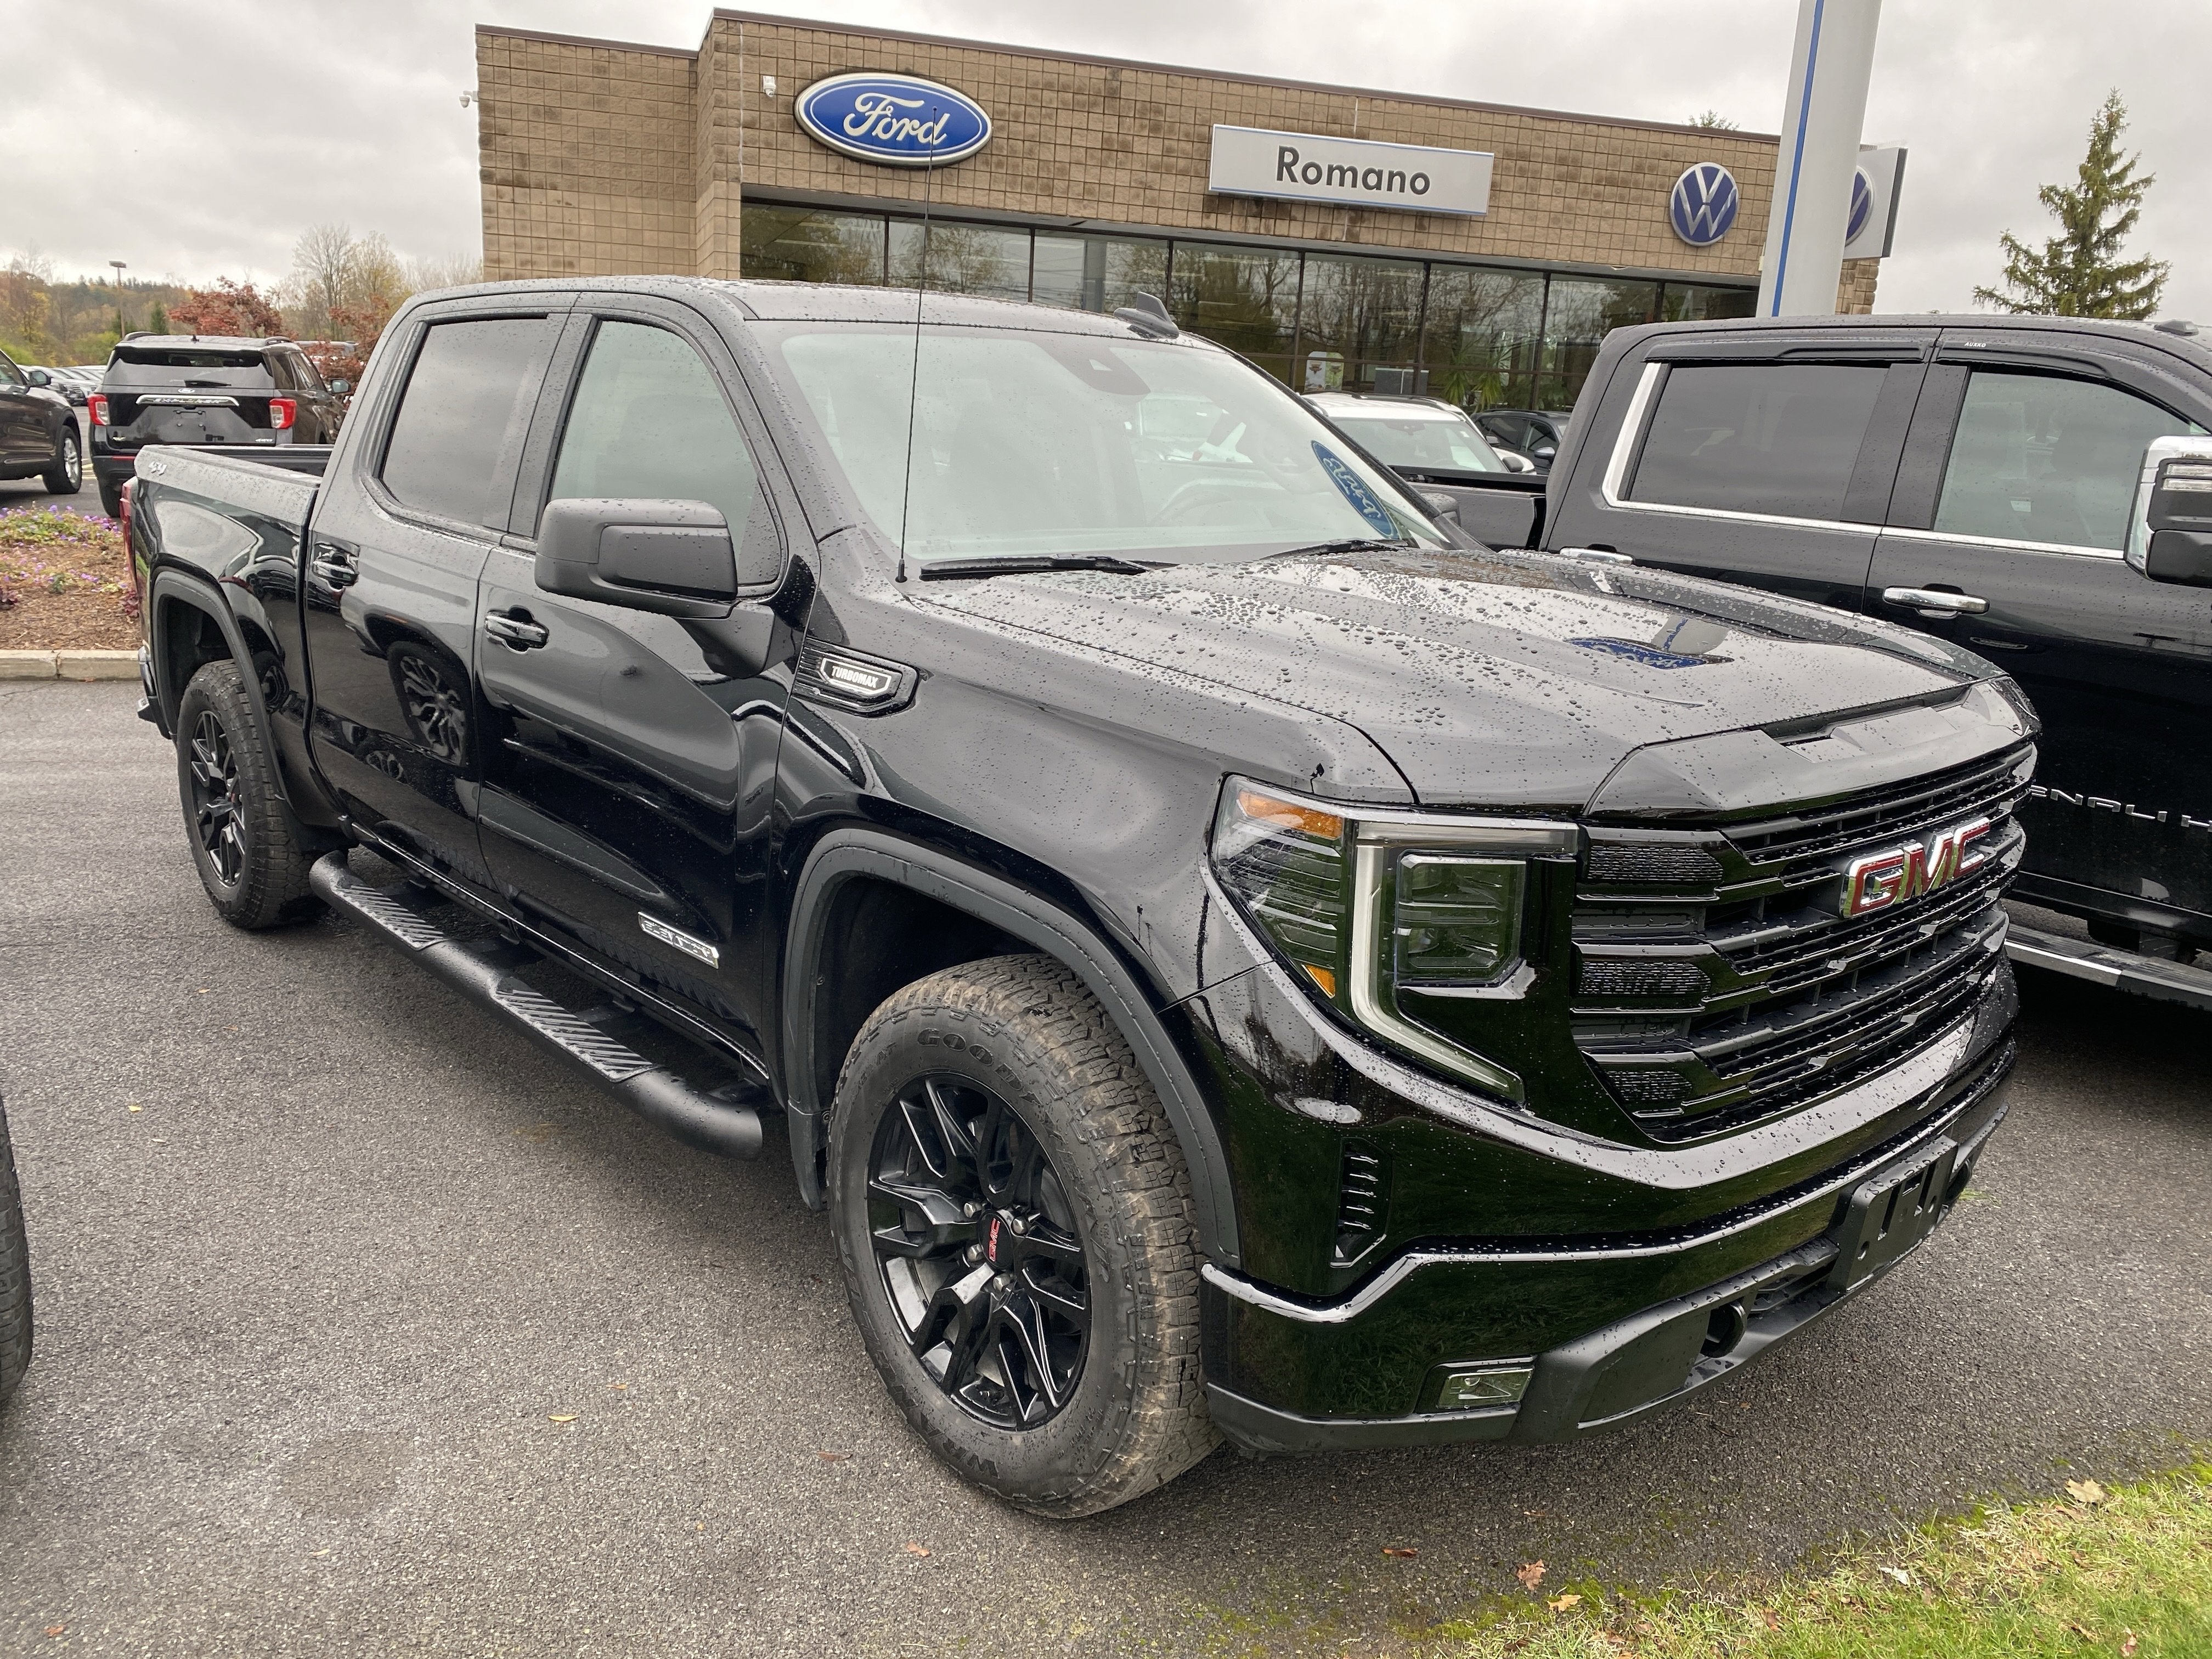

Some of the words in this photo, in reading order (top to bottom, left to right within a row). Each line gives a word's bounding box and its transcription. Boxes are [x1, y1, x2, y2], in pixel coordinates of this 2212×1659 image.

[843, 92, 950, 145] Ford
[1276, 145, 1431, 195] Romano
[832, 665, 879, 689] TURBOMAX
[2030, 785, 2168, 823] ENALI
[1839, 817, 1990, 918] GMC
[989, 1218, 1000, 1262] GMC
